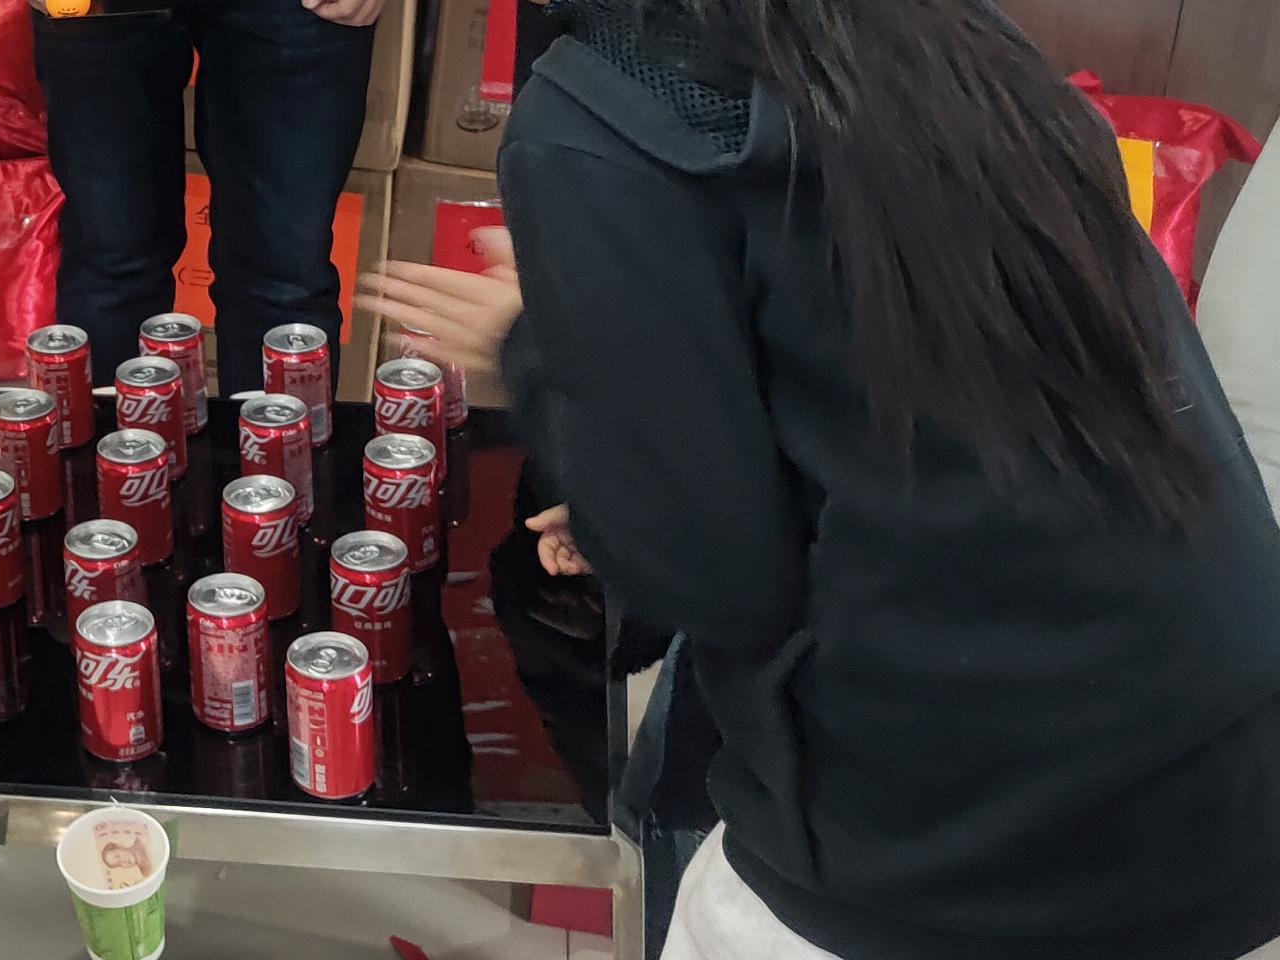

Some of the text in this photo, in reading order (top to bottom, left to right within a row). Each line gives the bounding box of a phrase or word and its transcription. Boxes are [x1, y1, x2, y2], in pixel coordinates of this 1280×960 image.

[116, 386, 177, 425] 可乐
[374, 393, 436, 428] 可乐
[363, 472, 432, 508] 可乐
[75, 649, 147, 690] 可乐
